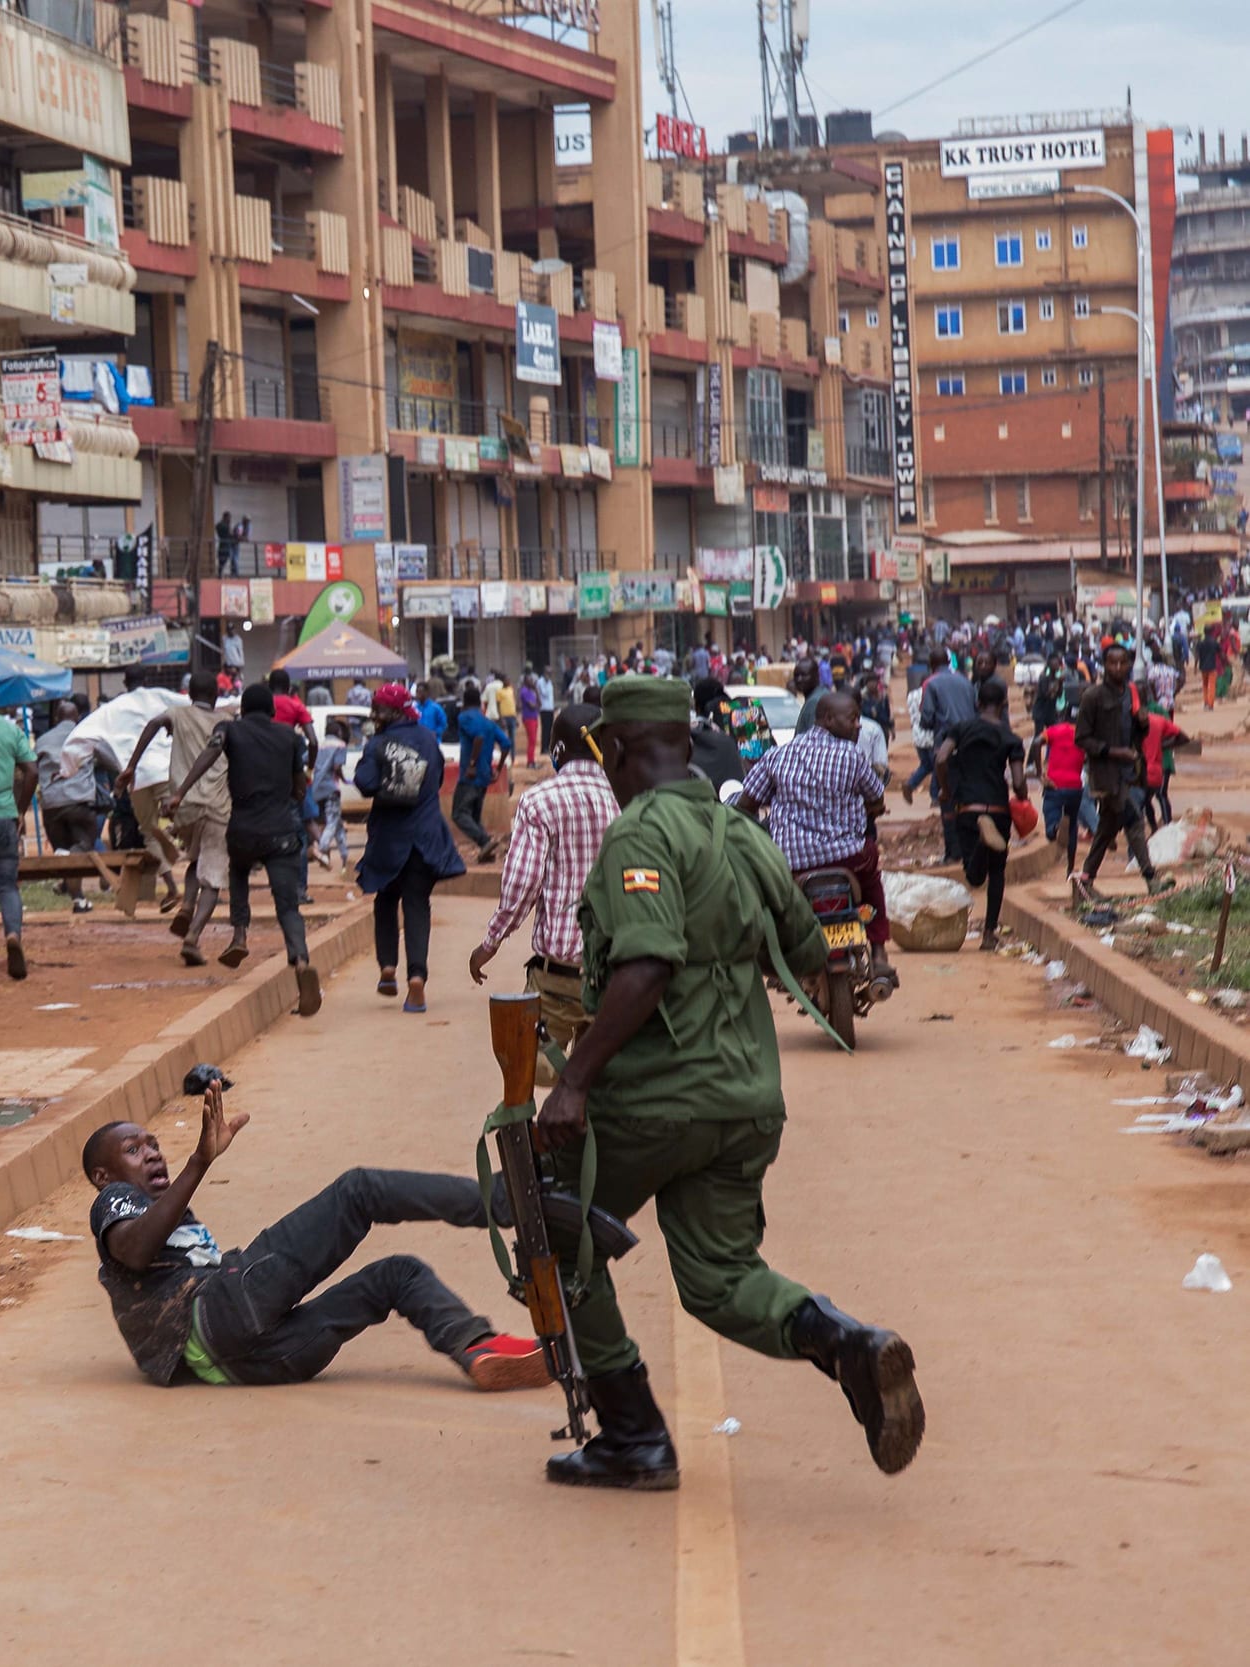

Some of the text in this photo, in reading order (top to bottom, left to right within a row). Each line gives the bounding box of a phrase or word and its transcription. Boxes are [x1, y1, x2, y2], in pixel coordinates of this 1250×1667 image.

[36, 50, 101, 126] CENTER
[945, 139, 1101, 167] KK TRUST HOTEL
[886, 166, 906, 265] CHAINS
[307, 667, 383, 678] ENJOY DIGITAL LIFE
